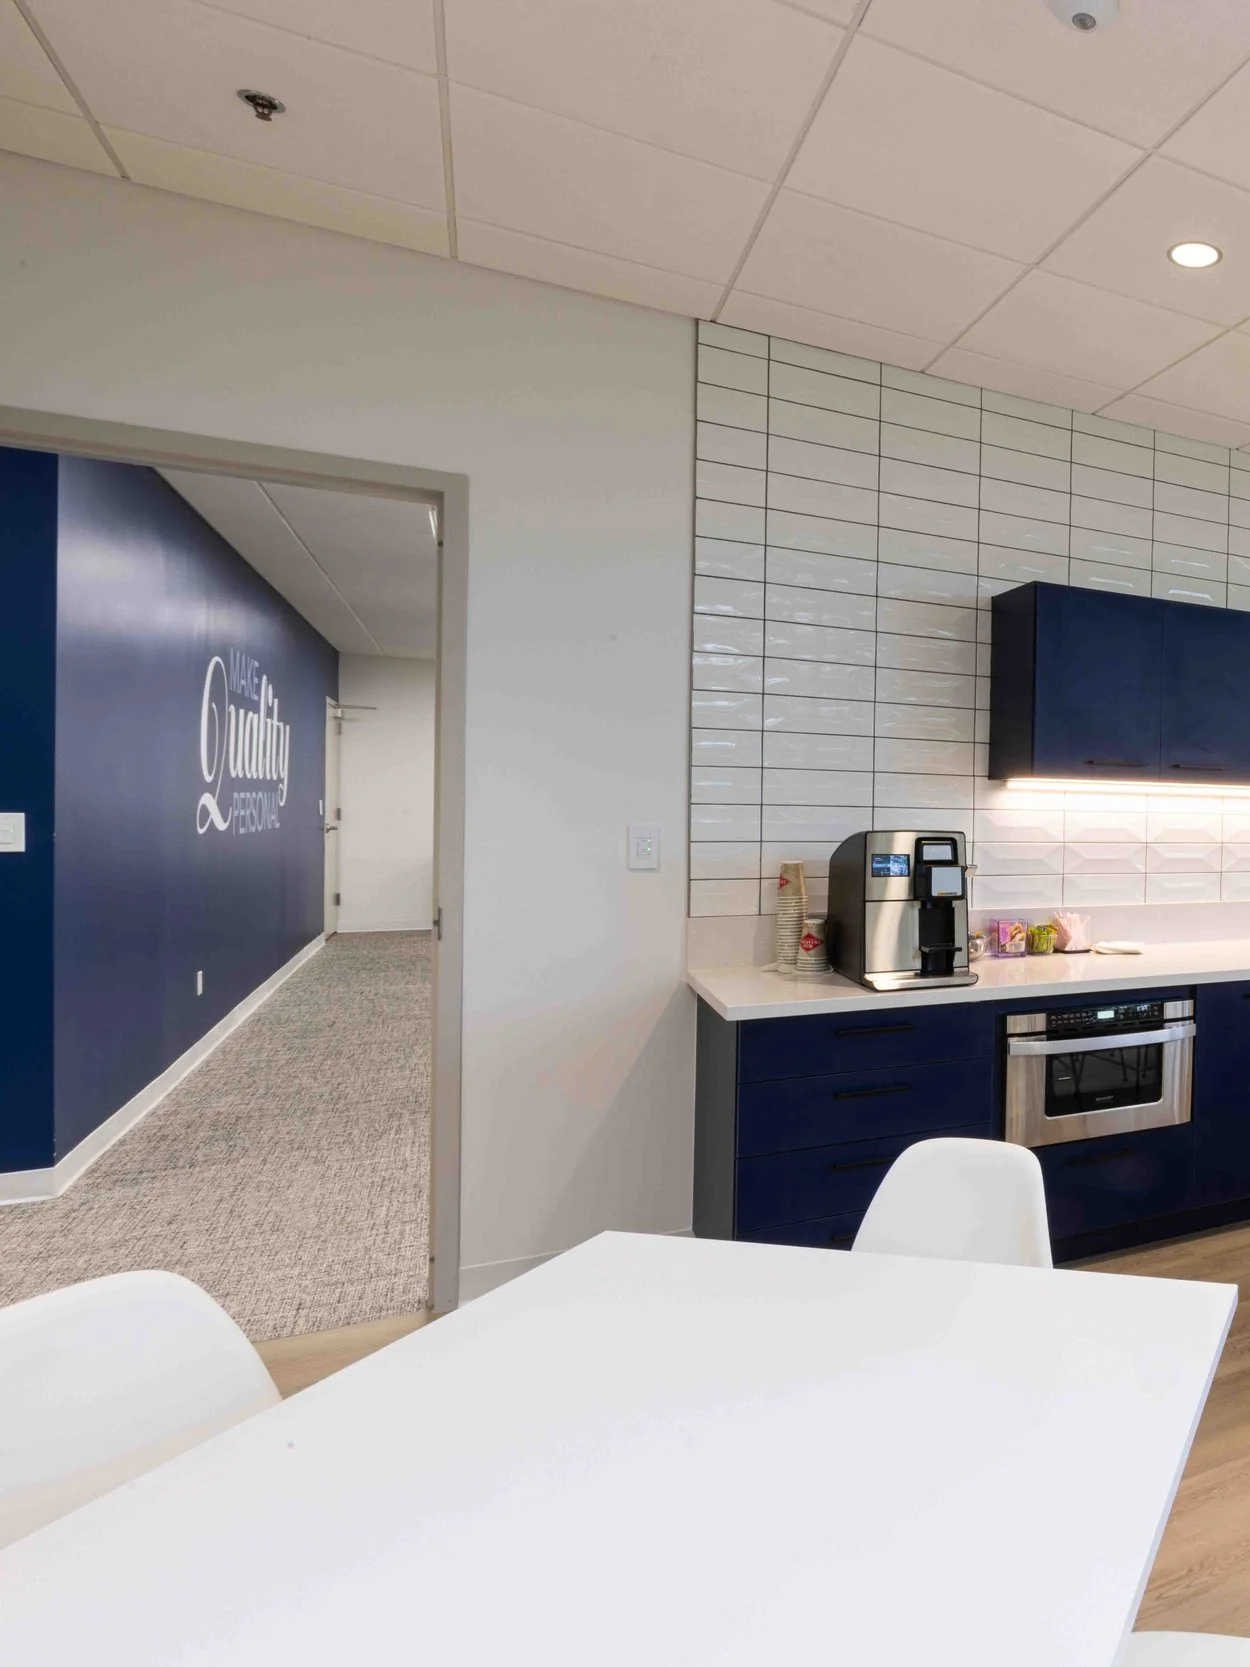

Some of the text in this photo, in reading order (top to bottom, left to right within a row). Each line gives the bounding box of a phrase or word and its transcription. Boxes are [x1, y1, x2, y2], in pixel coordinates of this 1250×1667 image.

[229, 646, 259, 701] MAKE
[196, 655, 290, 835] Quality
[232, 791, 280, 835] PERSONAL
